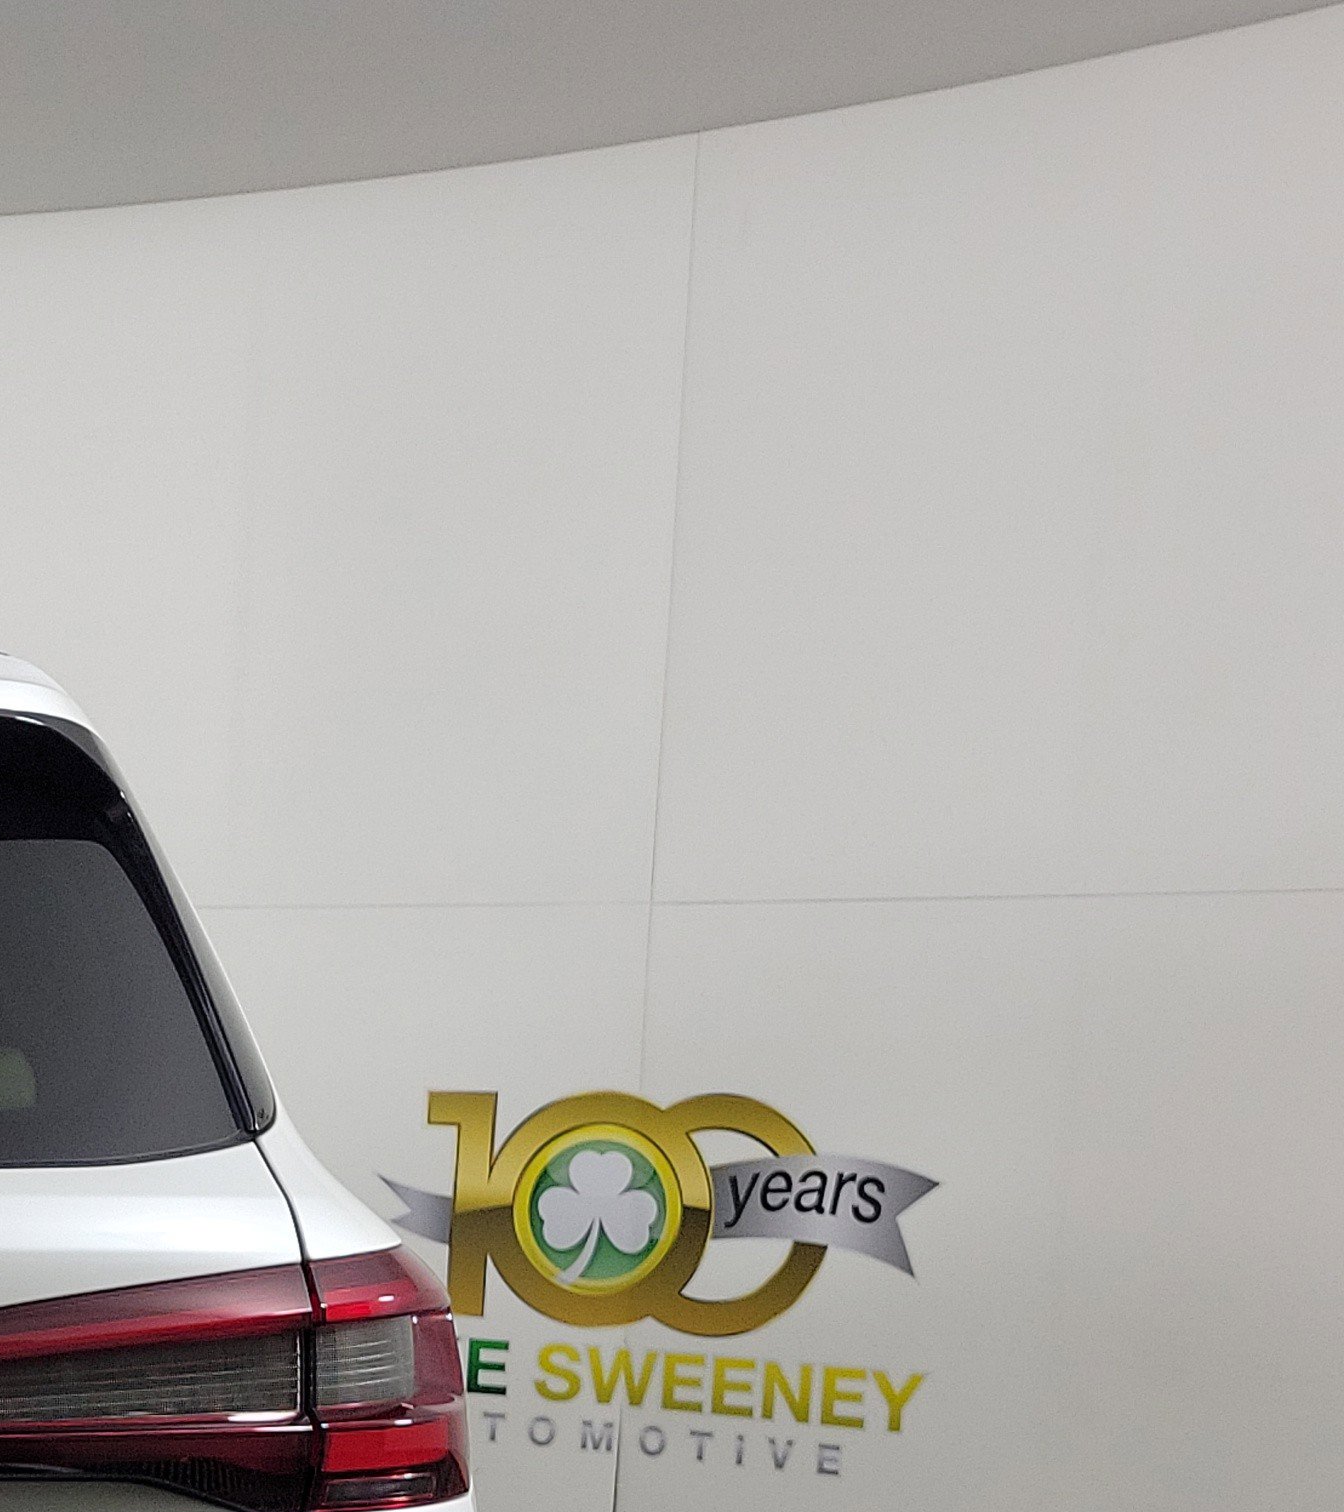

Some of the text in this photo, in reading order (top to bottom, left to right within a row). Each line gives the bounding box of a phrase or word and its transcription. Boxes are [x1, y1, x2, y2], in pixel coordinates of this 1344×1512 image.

[427, 1090, 828, 1336] 100
[725, 1169, 885, 1229] years
[534, 1342, 923, 1432] SWEENEY
[484, 1412, 841, 1476] TOMOTIVE
